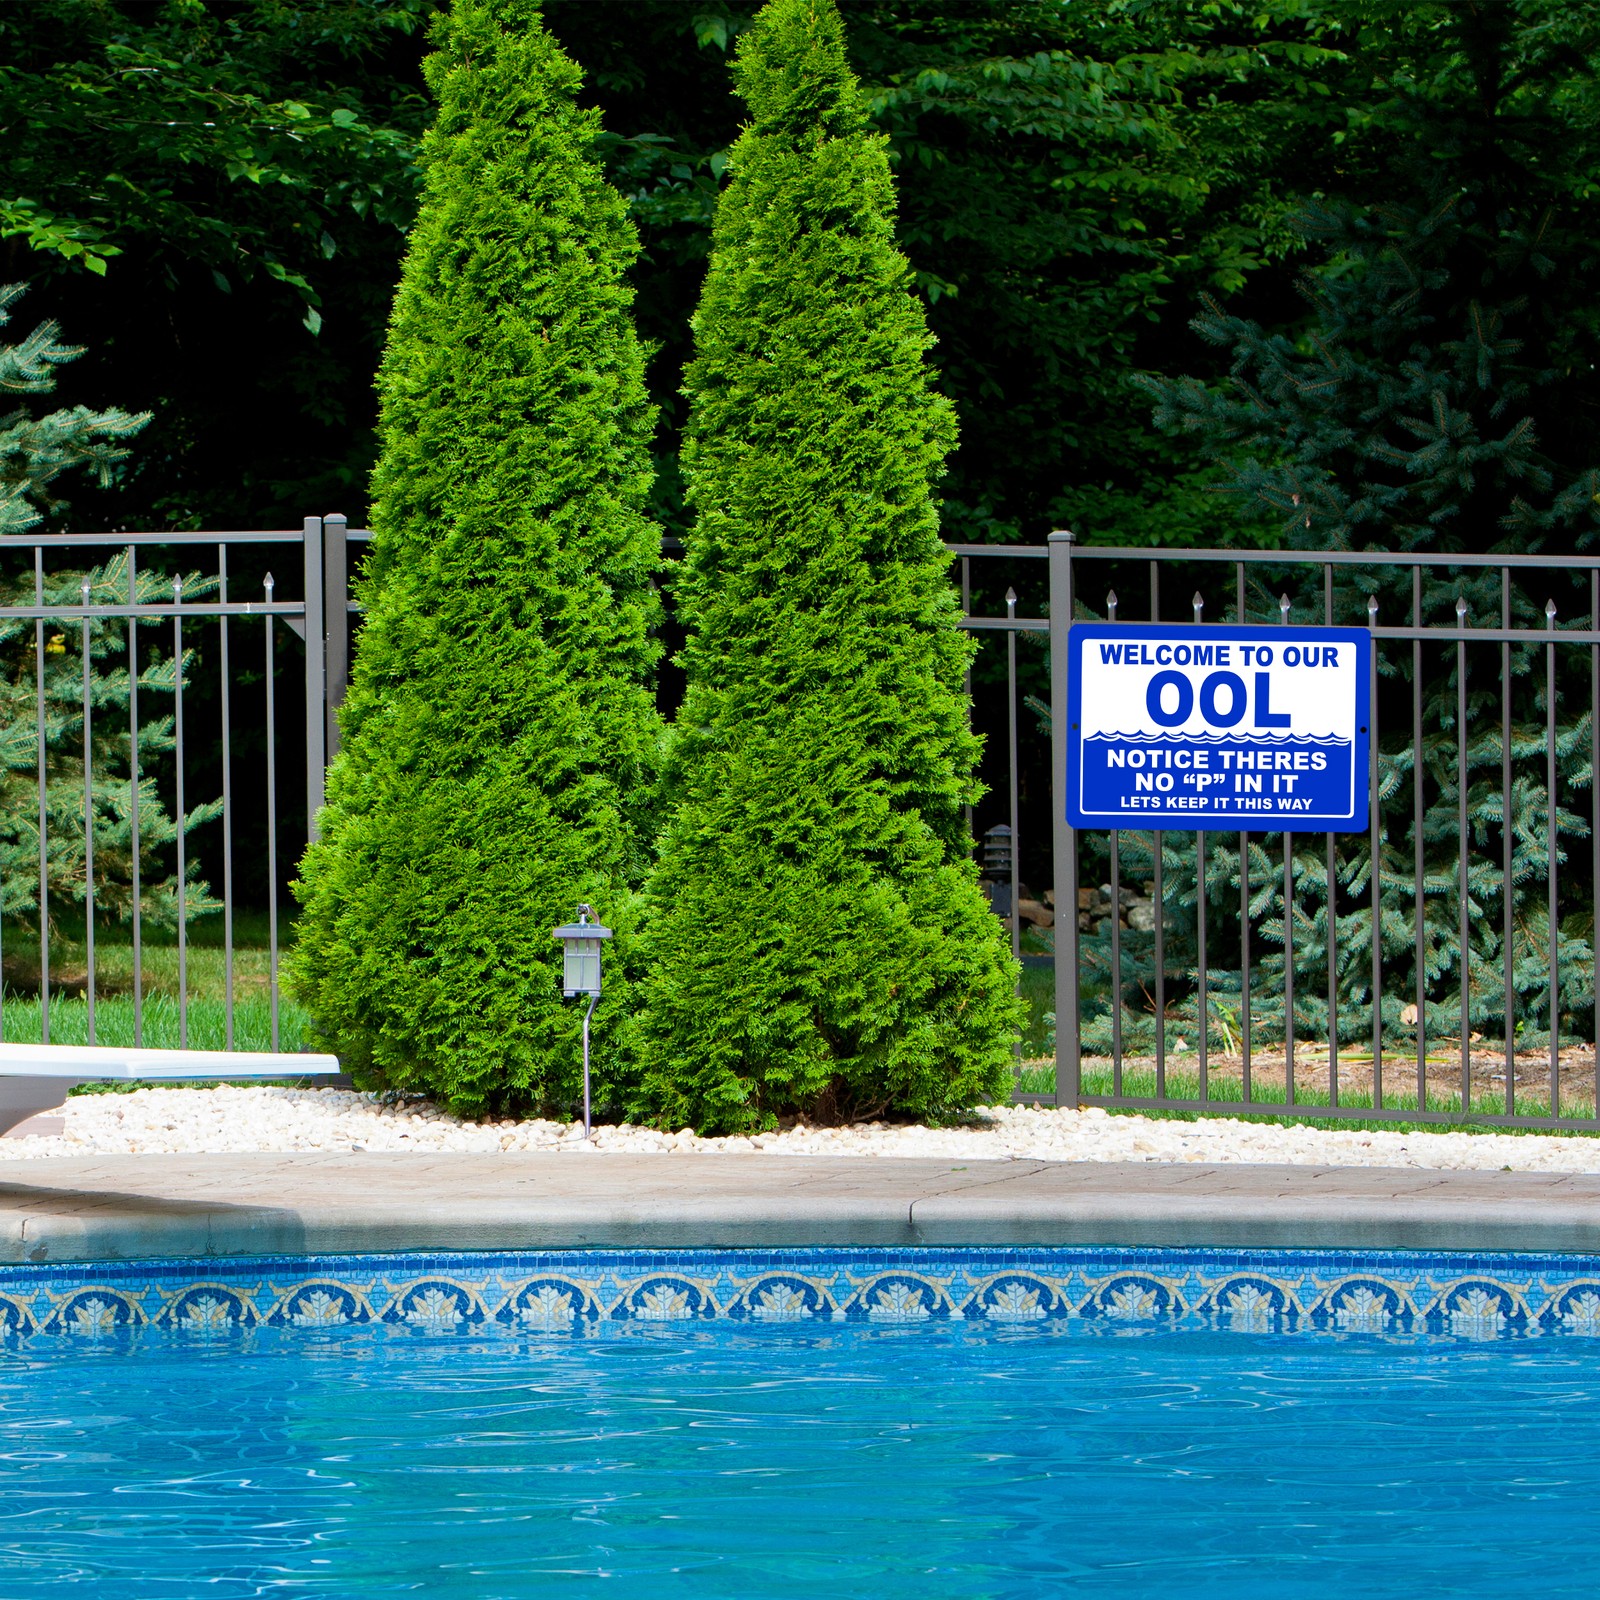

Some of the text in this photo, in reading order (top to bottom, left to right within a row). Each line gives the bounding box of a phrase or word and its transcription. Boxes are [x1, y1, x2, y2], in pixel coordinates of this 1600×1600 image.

[1100, 644, 1339, 668] WELCOME TO OUR
[1145, 670, 1291, 728] OOL
[1107, 749, 1327, 771] NOTICE THERES
[1135, 773, 1299, 793] NO “P” IN IT
[1121, 796, 1313, 810] LETS KEEP IT THIS WAY
